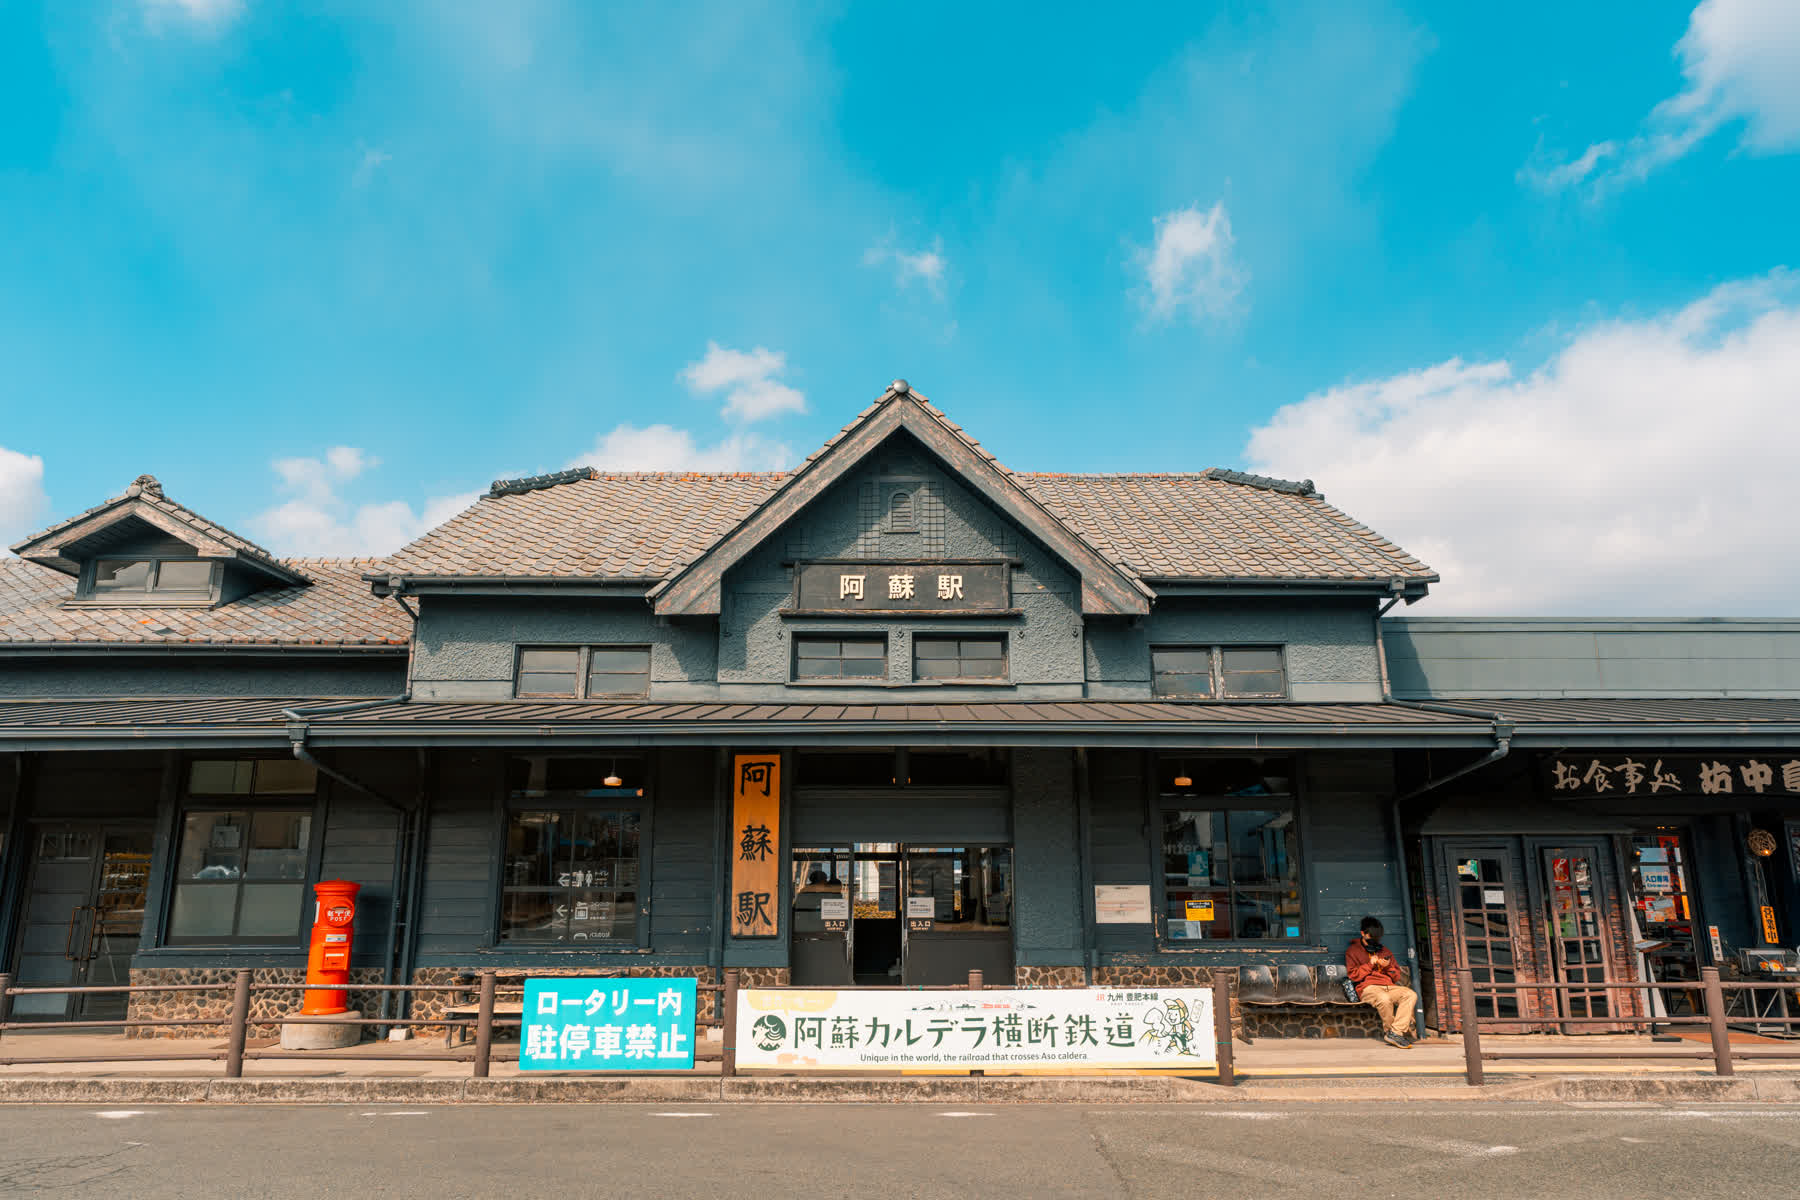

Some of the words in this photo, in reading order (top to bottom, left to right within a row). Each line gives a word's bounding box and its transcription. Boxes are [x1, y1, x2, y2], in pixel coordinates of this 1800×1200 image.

[840, 574, 964, 601] 阿蘇駅
[1552, 757, 1682, 794] お食事処
[736, 762, 776, 927] 阿蘇駅
[537, 988, 682, 1016] ロータリー内
[1107, 993, 1123, 1002] 九州
[1126, 992, 1159, 1002] 豊肥本線
[525, 1024, 689, 1060] 駐停車禁止
[794, 1012, 1135, 1050] 阿蘇カルデラ横断鉄道
[860, 1053, 888, 1063] Unique
[891, 1053, 899, 1061] in
[900, 1053, 914, 1061] the
[916, 1053, 942, 1063] world,
[944, 1053, 957, 1061] the
[959, 1052, 990, 1061] railroad
[992, 1053, 1008, 1061] that
[1010, 1053, 1040, 1061] crosses
[1041, 1052, 1056, 1060] Aso
[1058, 1051, 1088, 1060] caldera
